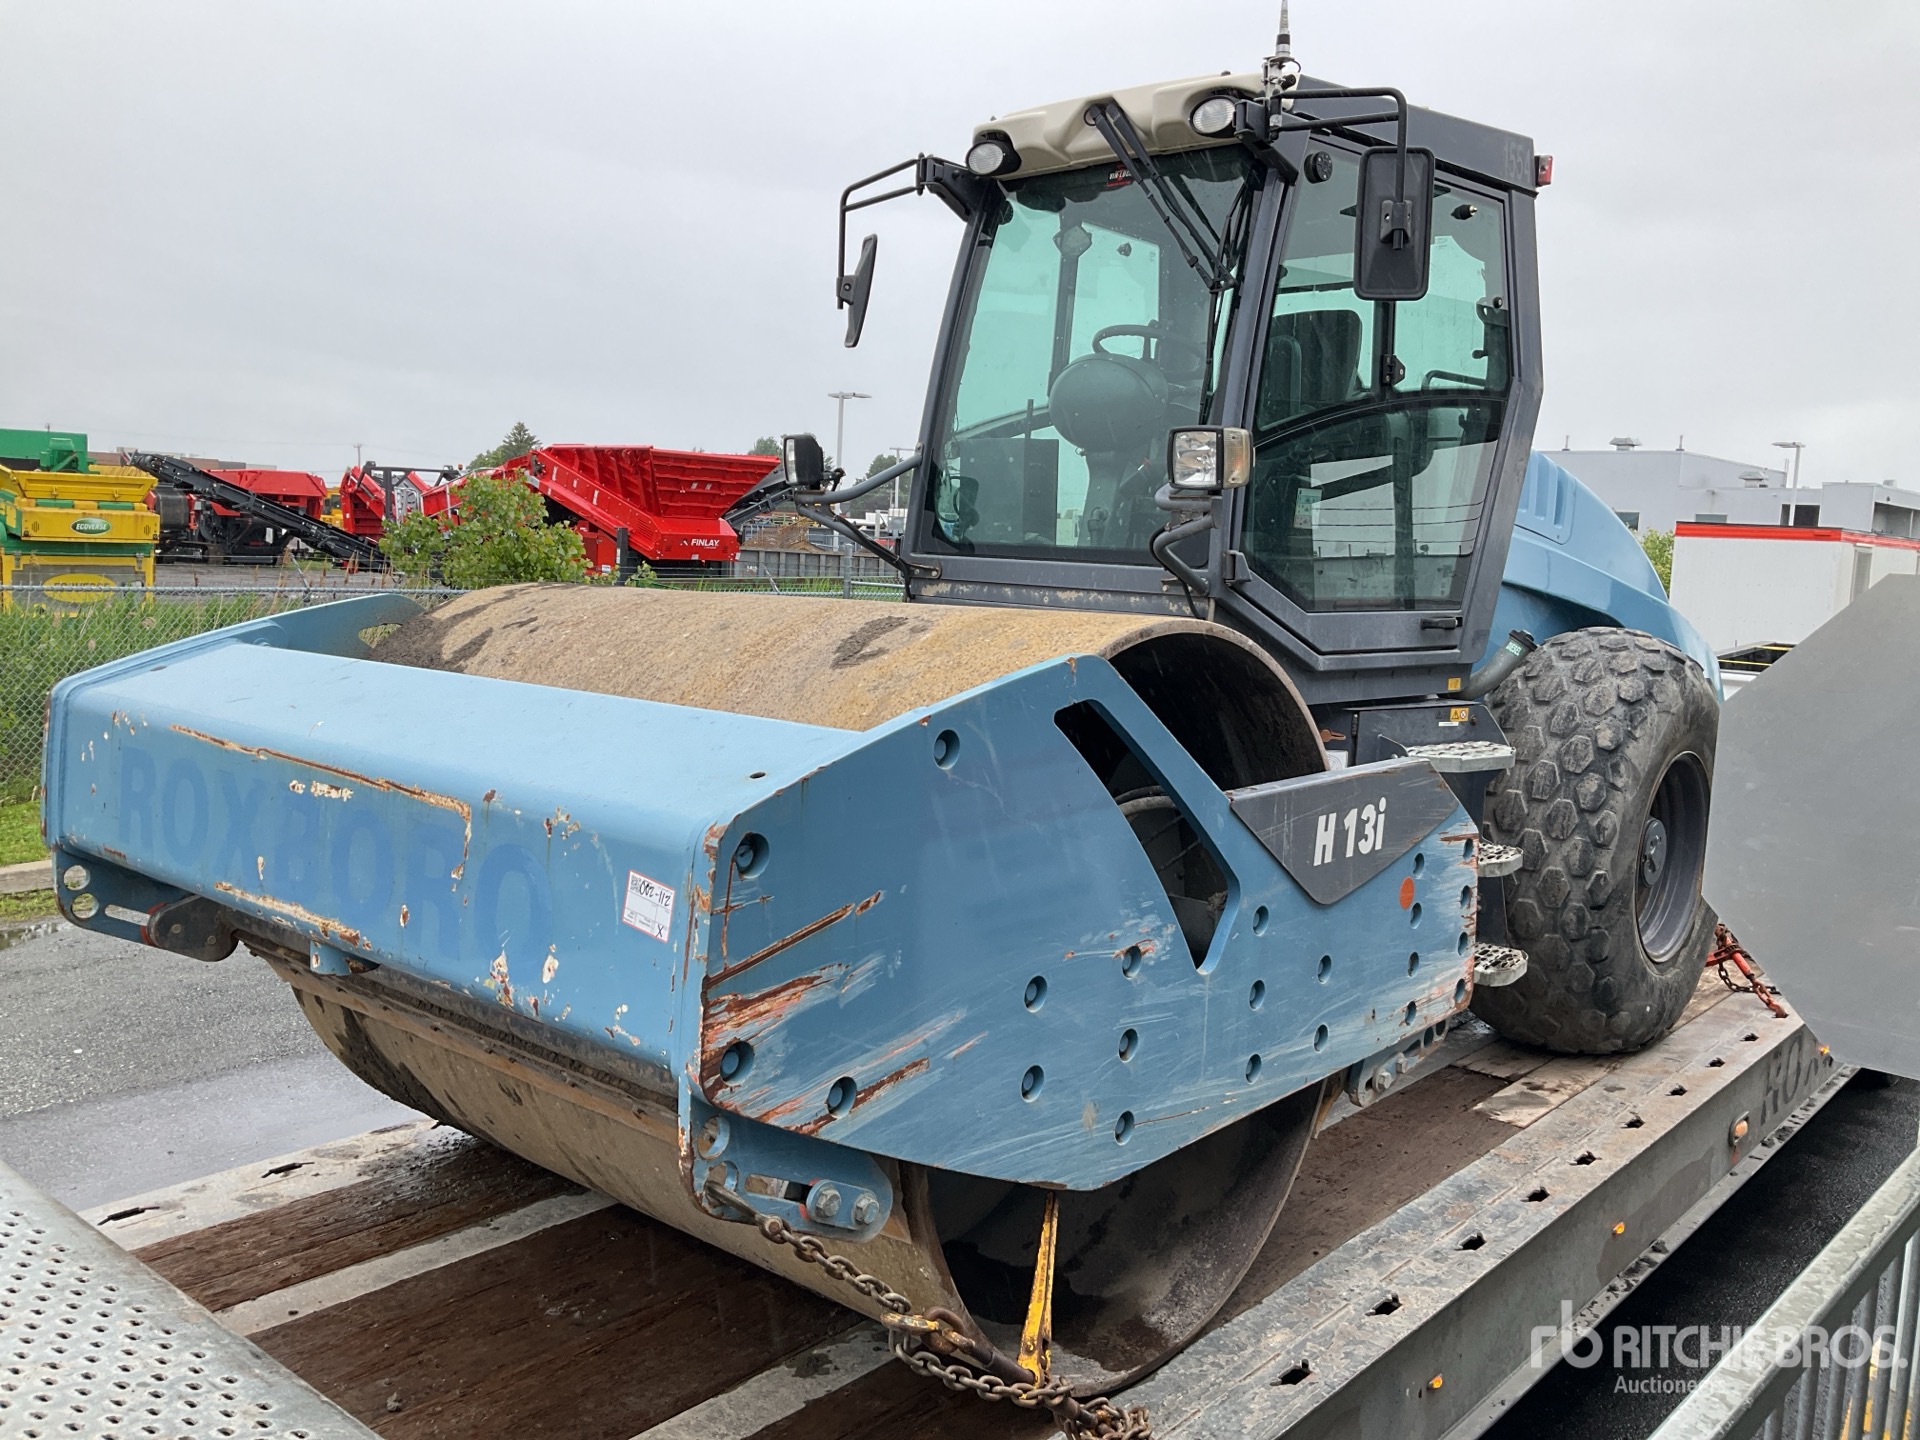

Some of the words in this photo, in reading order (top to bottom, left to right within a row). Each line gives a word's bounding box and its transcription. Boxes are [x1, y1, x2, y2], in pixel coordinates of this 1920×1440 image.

[76, 523, 107, 531] ECOVERSE
[690, 538, 720, 547] FINLAY
[1313, 812, 1337, 867] H
[1343, 797, 1387, 858] 13i
[118, 745, 554, 986] ROXBORO
